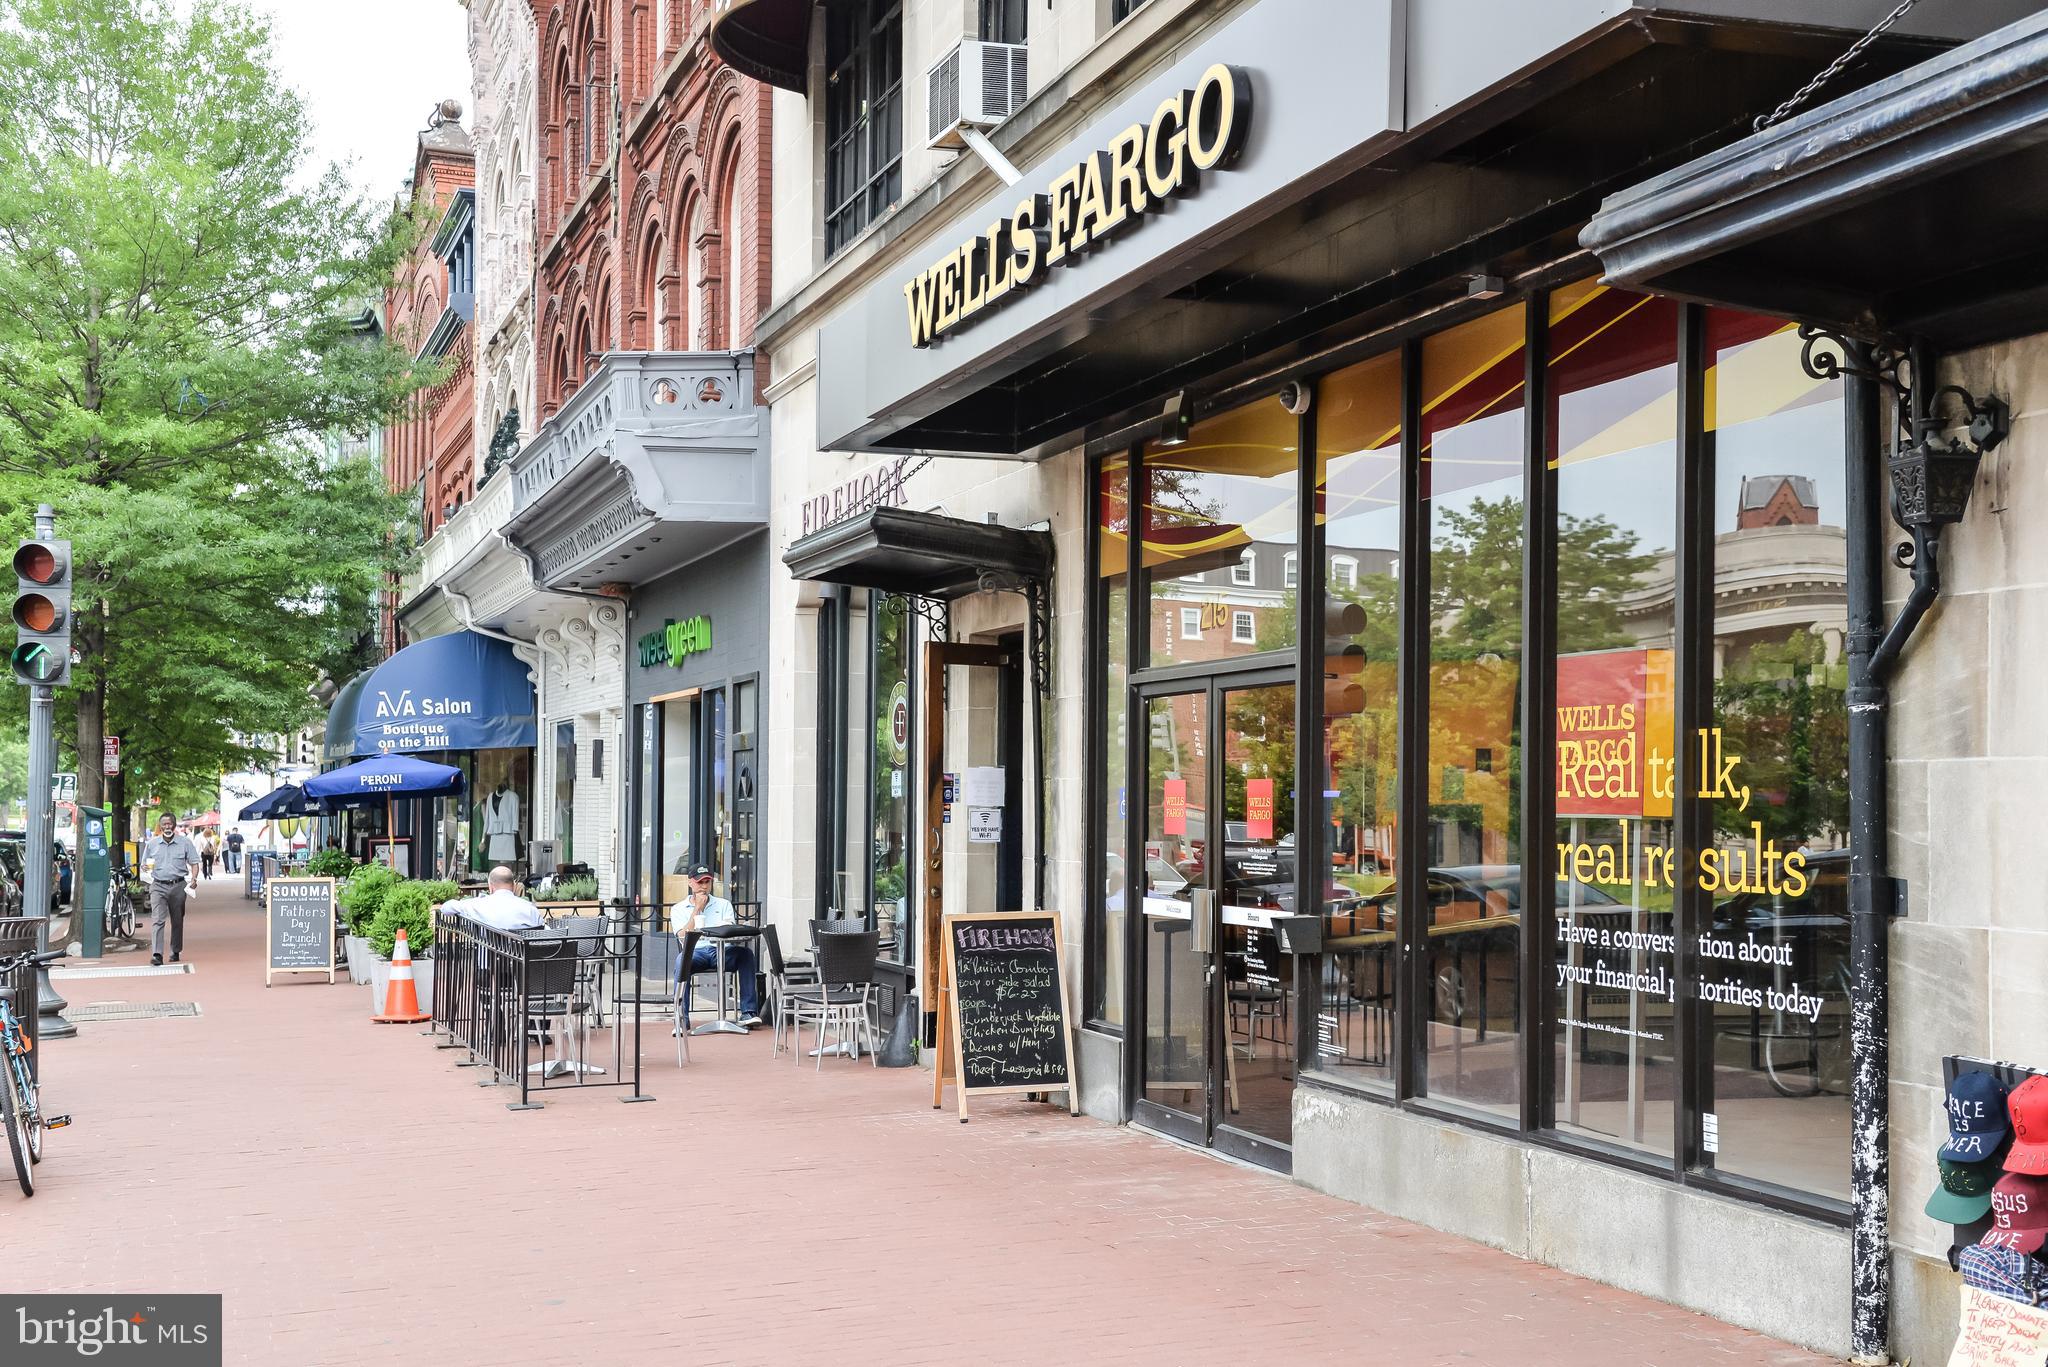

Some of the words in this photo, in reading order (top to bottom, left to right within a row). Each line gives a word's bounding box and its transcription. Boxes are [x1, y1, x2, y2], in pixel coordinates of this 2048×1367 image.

[904, 194, 1046, 348] WELLS
[1046, 63, 1246, 267] FARGO
[801, 457, 908, 538] FIREHOOK
[376, 690, 416, 717] AVA
[422, 698, 472, 715] Salon
[1557, 703, 1635, 732] WELLS
[383, 724, 444, 737] Boutique
[378, 739, 396, 749] on
[400, 736, 421, 748] the
[425, 735, 449, 747] Hill
[1557, 732, 1640, 798] Real
[360, 773, 402, 786] PERONI
[1165, 796, 1184, 806] WELLS
[1248, 797, 1271, 807] WELLS
[1165, 808, 1184, 818] FARGO
[1249, 810, 1271, 820] FARGO
[1557, 819, 1632, 885] real
[272, 885, 329, 897] SONOMA
[280, 905, 326, 918] Father's
[291, 918, 310, 934] Day
[283, 932, 322, 944] Brunch!
[957, 926, 1055, 948] FIREHOOK
[1557, 918, 1597, 945] Have
[1601, 929, 1610, 946] a
[1614, 931, 1734, 960] converstion
[1738, 933, 1793, 966] about
[985, 978, 995, 987] or
[1022, 974, 1051, 988] salad
[1557, 964, 1596, 987] your
[1596, 960, 1666, 995] financial
[1767, 984, 1824, 1023] today
[964, 1023, 1008, 1040] Chicken
[1010, 1021, 1056, 1040] Dumpling
[1954, 1119, 1969, 1132] IS
[1995, 1213, 2011, 1229] IS
[1980, 1229, 2023, 1250] LOVE
[1981, 1313, 2007, 1330] KEEP
[2007, 1304, 2048, 1330] DONATE
[2008, 1341, 2036, 1356] AND
